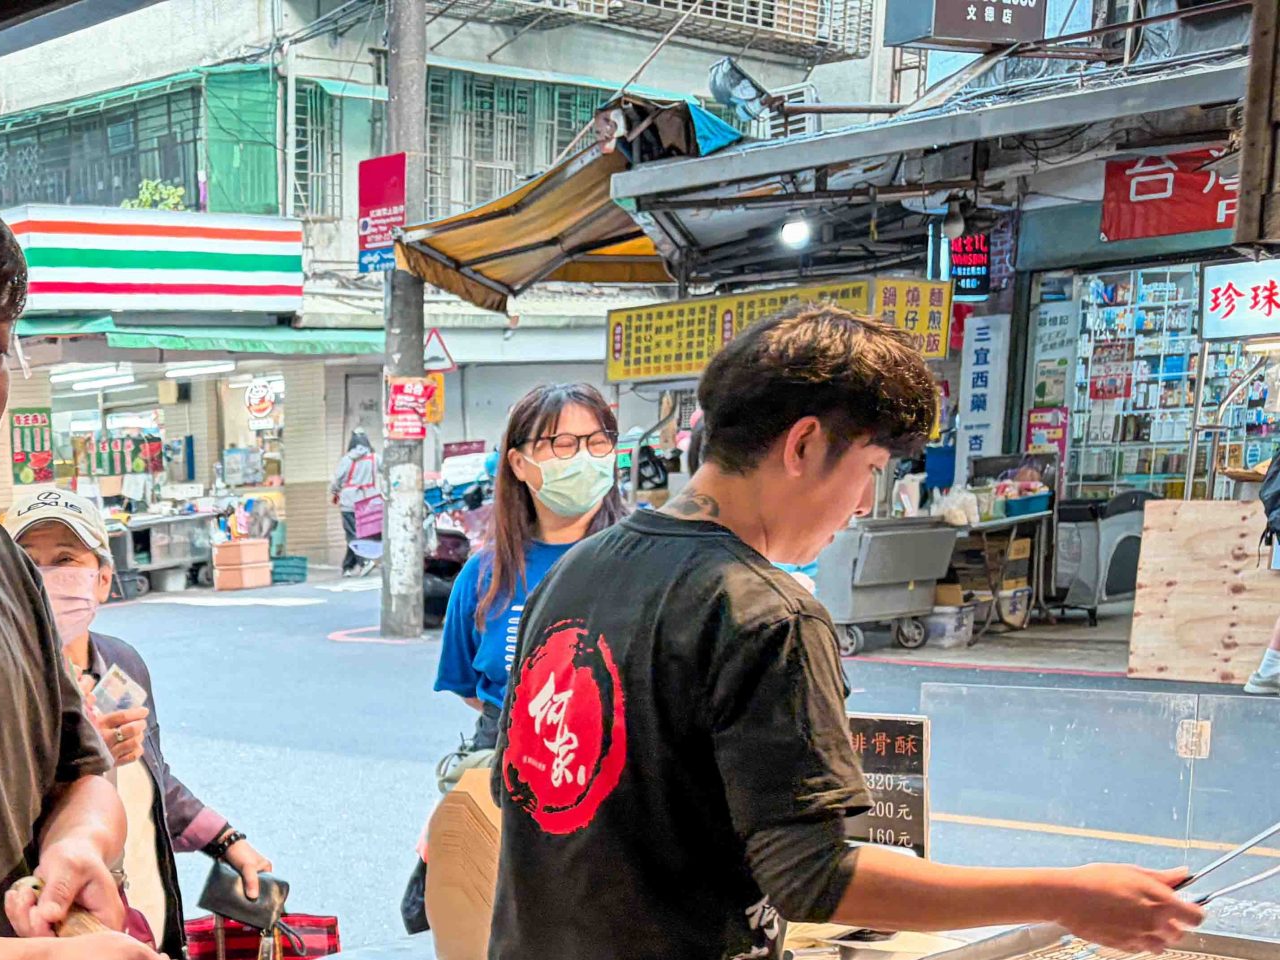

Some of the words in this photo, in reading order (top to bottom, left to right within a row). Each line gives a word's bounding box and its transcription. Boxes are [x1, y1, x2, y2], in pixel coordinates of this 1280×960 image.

[966, 5, 1013, 24] 文德店
[882, 286, 944, 307] 鍋燒麵
[1209, 279, 1280, 319] 珍珠
[970, 326, 991, 413] 三宜西藥
